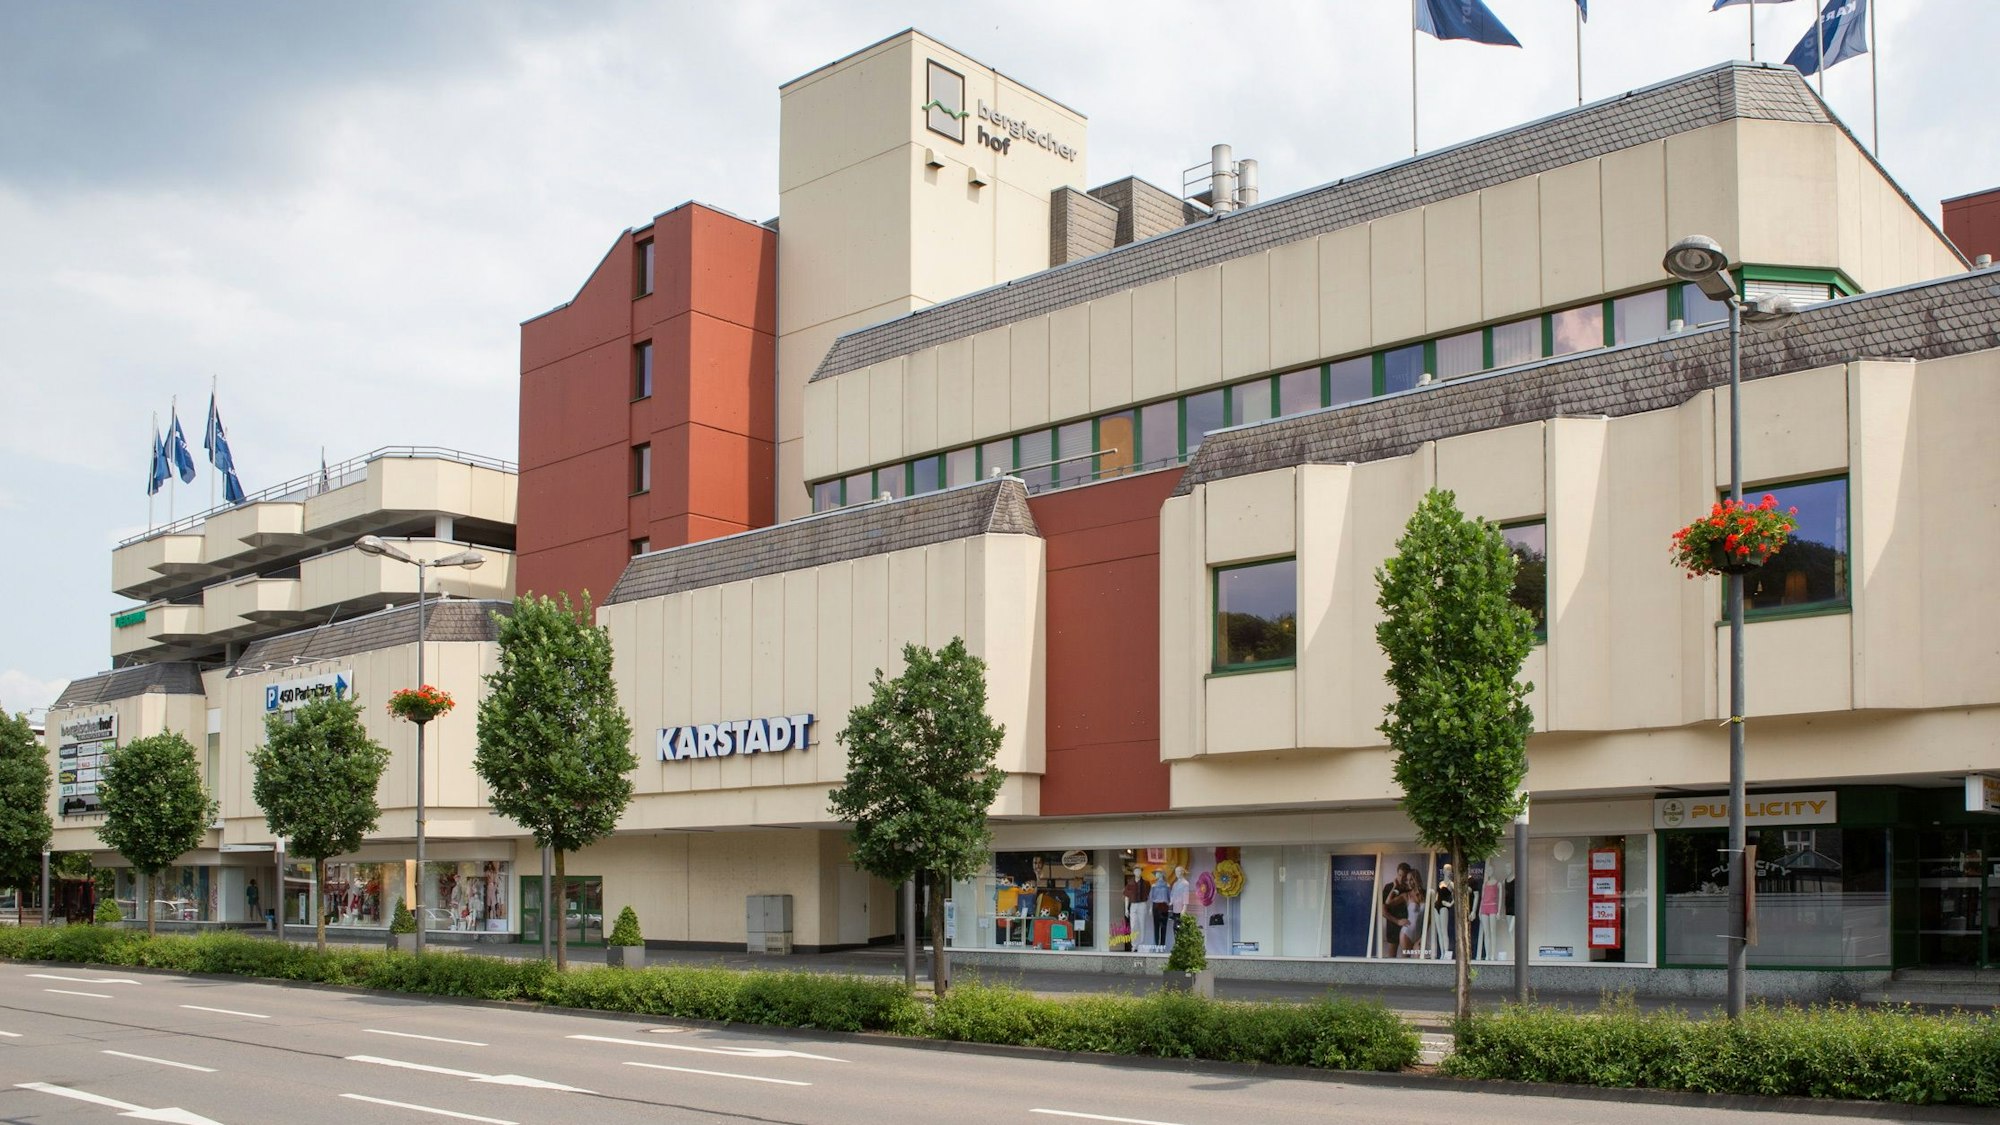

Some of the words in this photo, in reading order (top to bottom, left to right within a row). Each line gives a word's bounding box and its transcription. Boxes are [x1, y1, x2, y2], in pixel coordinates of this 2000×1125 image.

[977, 98, 1078, 163] bergischer
[977, 125, 1012, 156] hof
[279, 689, 294, 704] 450
[656, 713, 813, 762] KARSTADT
[1691, 799, 1828, 819] PULICITY
